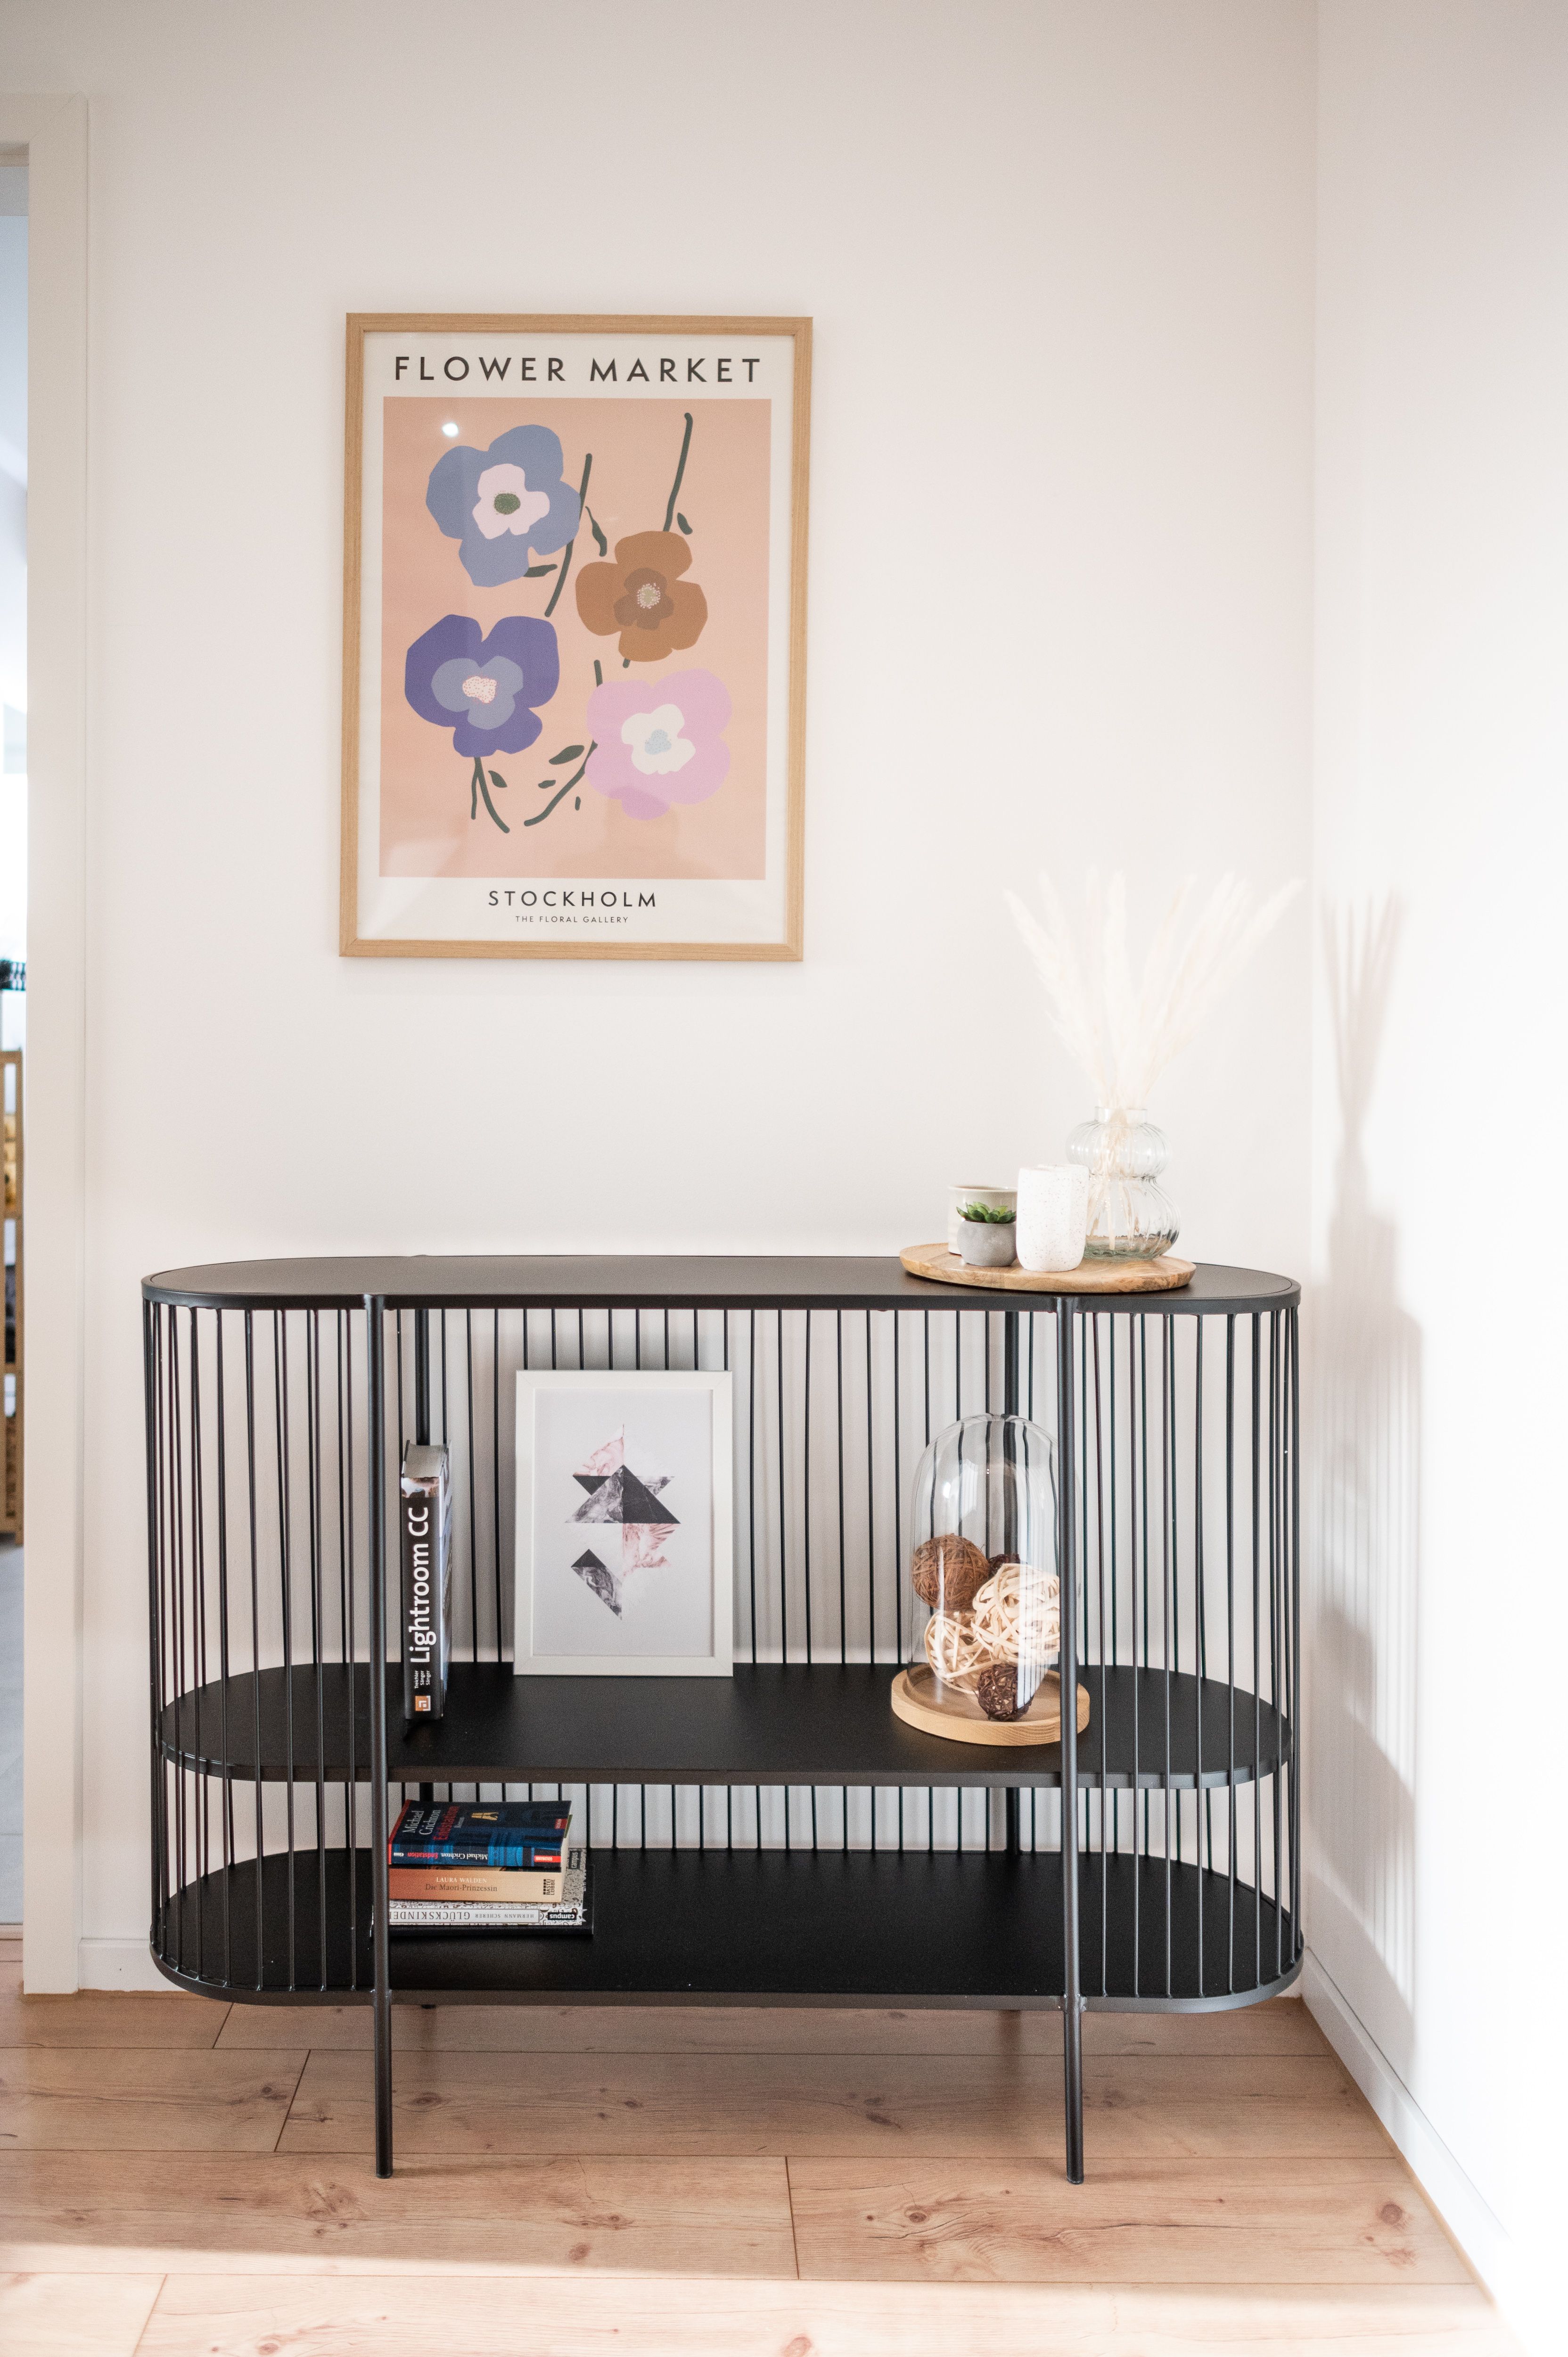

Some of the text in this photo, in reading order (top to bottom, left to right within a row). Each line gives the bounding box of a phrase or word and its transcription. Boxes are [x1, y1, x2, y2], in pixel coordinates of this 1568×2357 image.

[394, 356, 760, 383] FLOWER MARKET
[488, 890, 656, 907] STOCKHOLM
[409, 1507, 436, 1663] Lightroom CC
[402, 1811, 424, 1833] Michael
[419, 1810, 441, 1835] Crichton
[433, 1806, 460, 1840] Endstation
